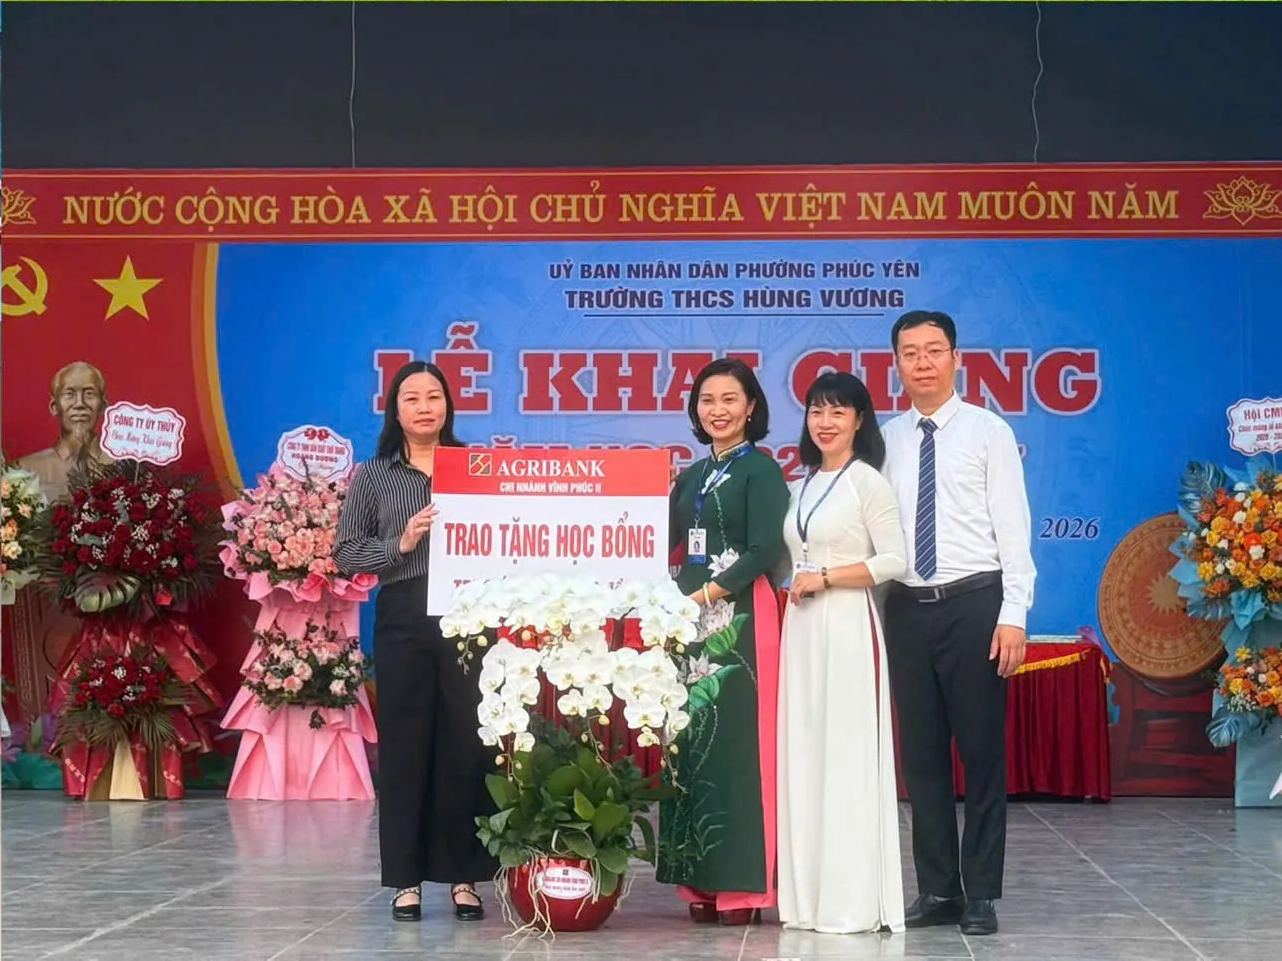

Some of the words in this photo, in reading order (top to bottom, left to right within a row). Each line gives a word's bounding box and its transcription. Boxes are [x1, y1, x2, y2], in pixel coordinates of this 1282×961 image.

[63, 191, 165, 225] NƯỚC
[175, 187, 280, 233] CỘNG
[291, 186, 372, 225] HÒA
[382, 188, 437, 223] XÃ
[448, 185, 517, 230] HỘI
[530, 180, 607, 223] CHỦ
[619, 186, 744, 222] NGHĨA
[755, 182, 846, 229] VIỆT
[856, 191, 948, 221] NAM
[957, 181, 1075, 220] MUÔN
[1087, 181, 1179, 218] NĂM
[548, 259, 575, 280] UỶ
[579, 264, 620, 280] BAN
[627, 260, 682, 279] NHÂN
[688, 260, 730, 279] DÂN
[736, 259, 815, 279] PHƯỜNG
[822, 258, 876, 279] PHÚC
[882, 258, 919, 278] YÊN
[565, 285, 663, 310] TRƯỜNG
[672, 289, 735, 309] THCS
[742, 285, 811, 309] HÙNG
[820, 287, 904, 308] VƯƠNG
[113, 413, 134, 427] CÔNG
[1244, 408, 1261, 421] HỘI
[496, 459, 605, 477] AGRIBANK
[500, 482, 516, 492] CHI
[517, 481, 546, 493] NHÁNH
[548, 481, 568, 493] VĨNH
[570, 481, 594, 493] PHÚC
[444, 523, 492, 556] TRAO
[499, 517, 549, 564] TẶNG
[556, 524, 594, 565] HỌC
[601, 511, 655, 558] BỔNG
[1040, 518, 1099, 538] 2026
